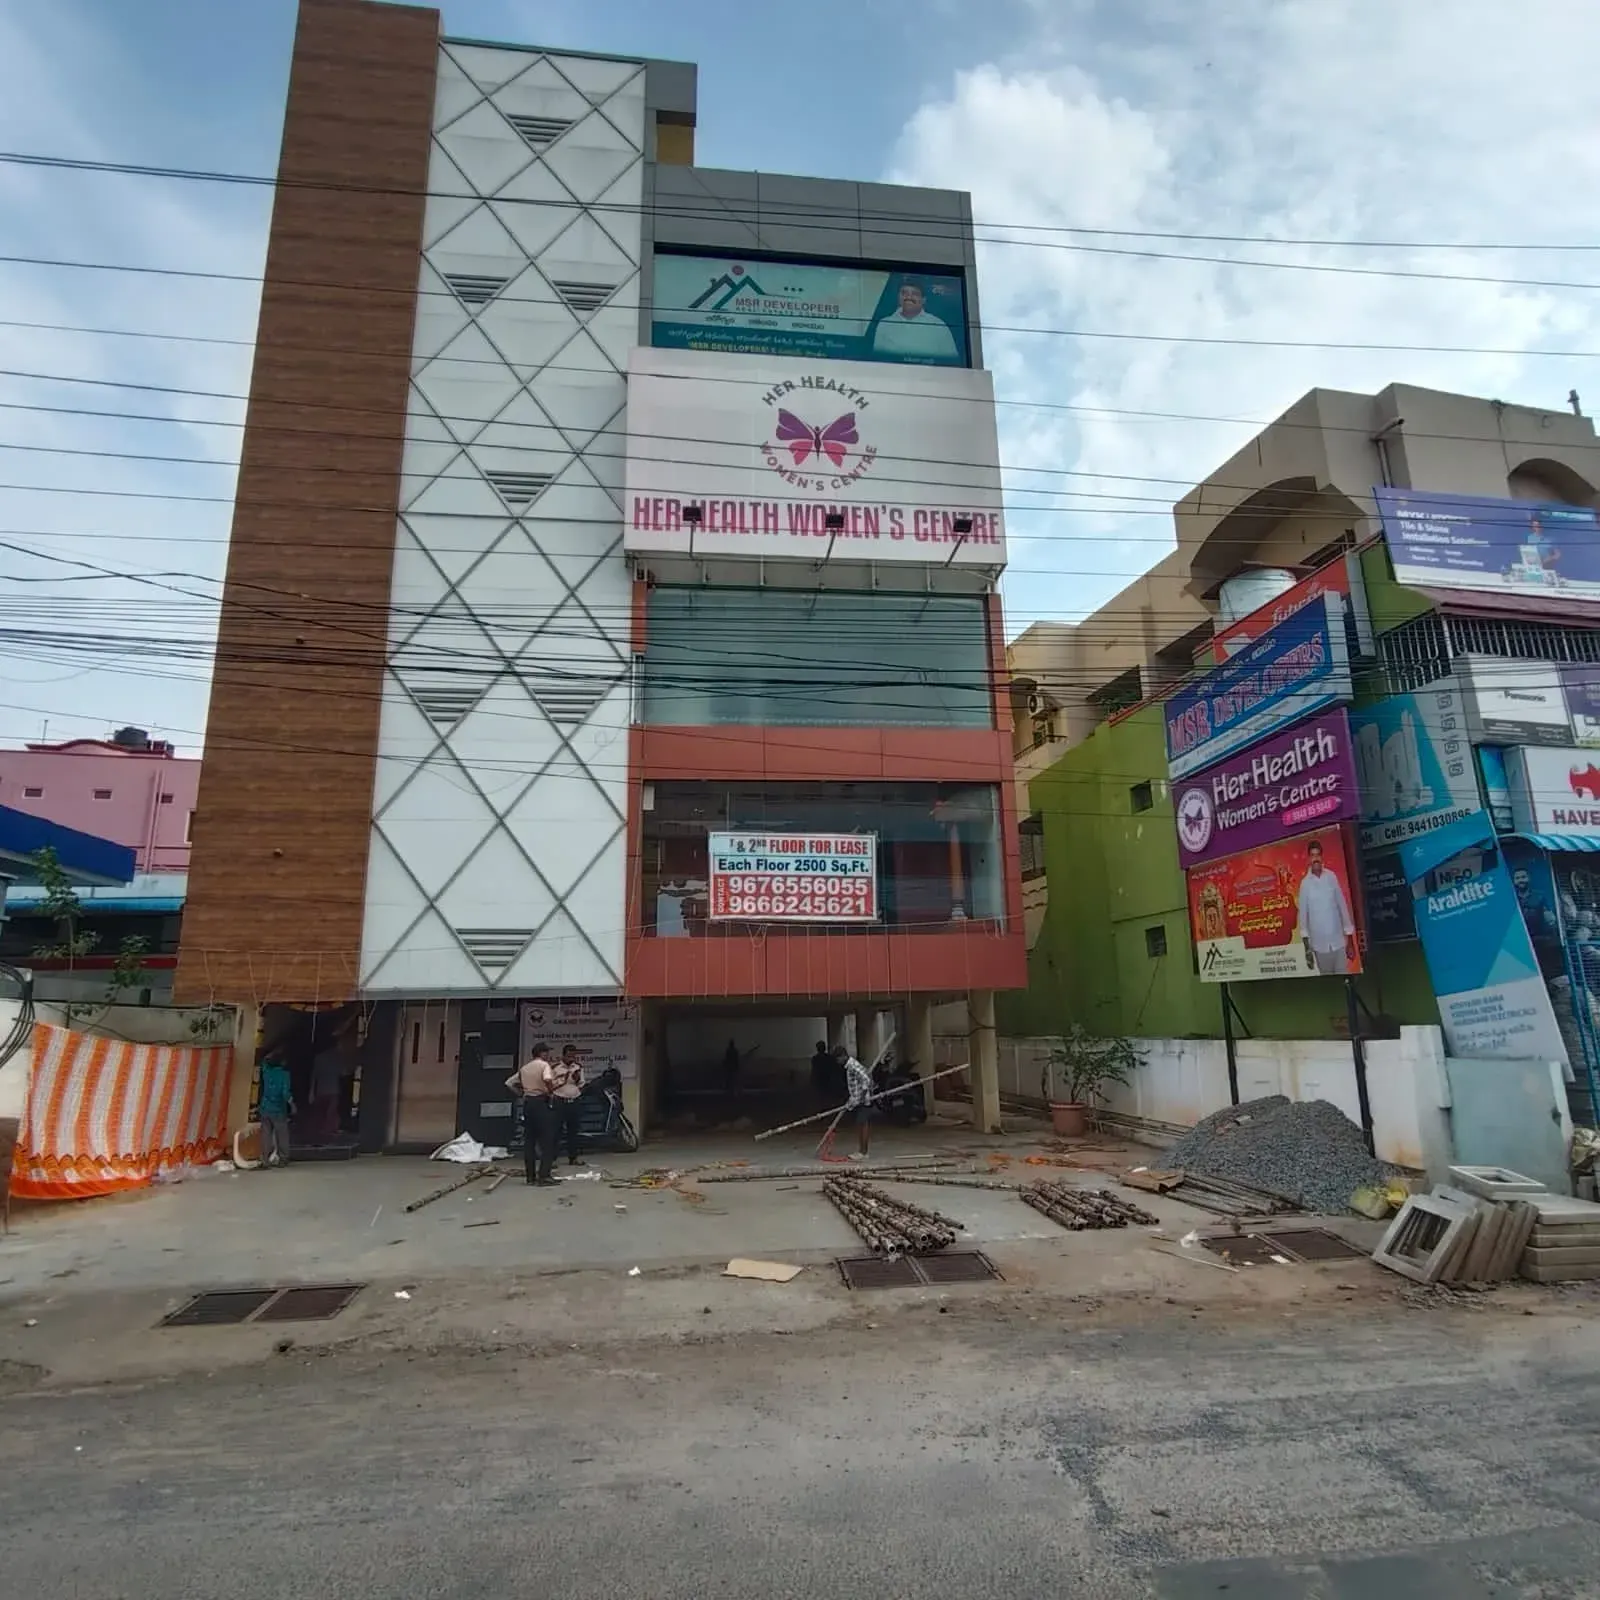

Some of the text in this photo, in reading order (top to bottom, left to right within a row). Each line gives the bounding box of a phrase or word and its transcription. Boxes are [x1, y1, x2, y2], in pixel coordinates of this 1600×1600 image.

[735, 298, 840, 314] MSR DEVELOPERS
[762, 375, 870, 410] HER HEALTH
[760, 440, 878, 491] WOMEN'S CENTRE
[634, 496, 681, 531] HER
[691, 500, 780, 536] HEALTH
[787, 503, 905, 541] WOMEN'S
[1169, 699, 1212, 757] MSR
[1213, 632, 1325, 727] DEVELOPERS
[1252, 727, 1338, 789] Health
[1217, 794, 1279, 831] Women's
[1279, 774, 1340, 808] Centre
[737, 841, 746, 853] &
[770, 839, 806, 854] FLOOR
[809, 840, 831, 854] FOR
[834, 841, 868, 855] LEASE
[1384, 823, 1406, 839] Cell:
[718, 859, 869, 875] Each Floor 2500 Sq.Ft.
[717, 878, 726, 913] CONTACT
[729, 876, 868, 895] 9676556055
[1428, 882, 1495, 914] Araldite
[729, 896, 868, 914] 9666245621
